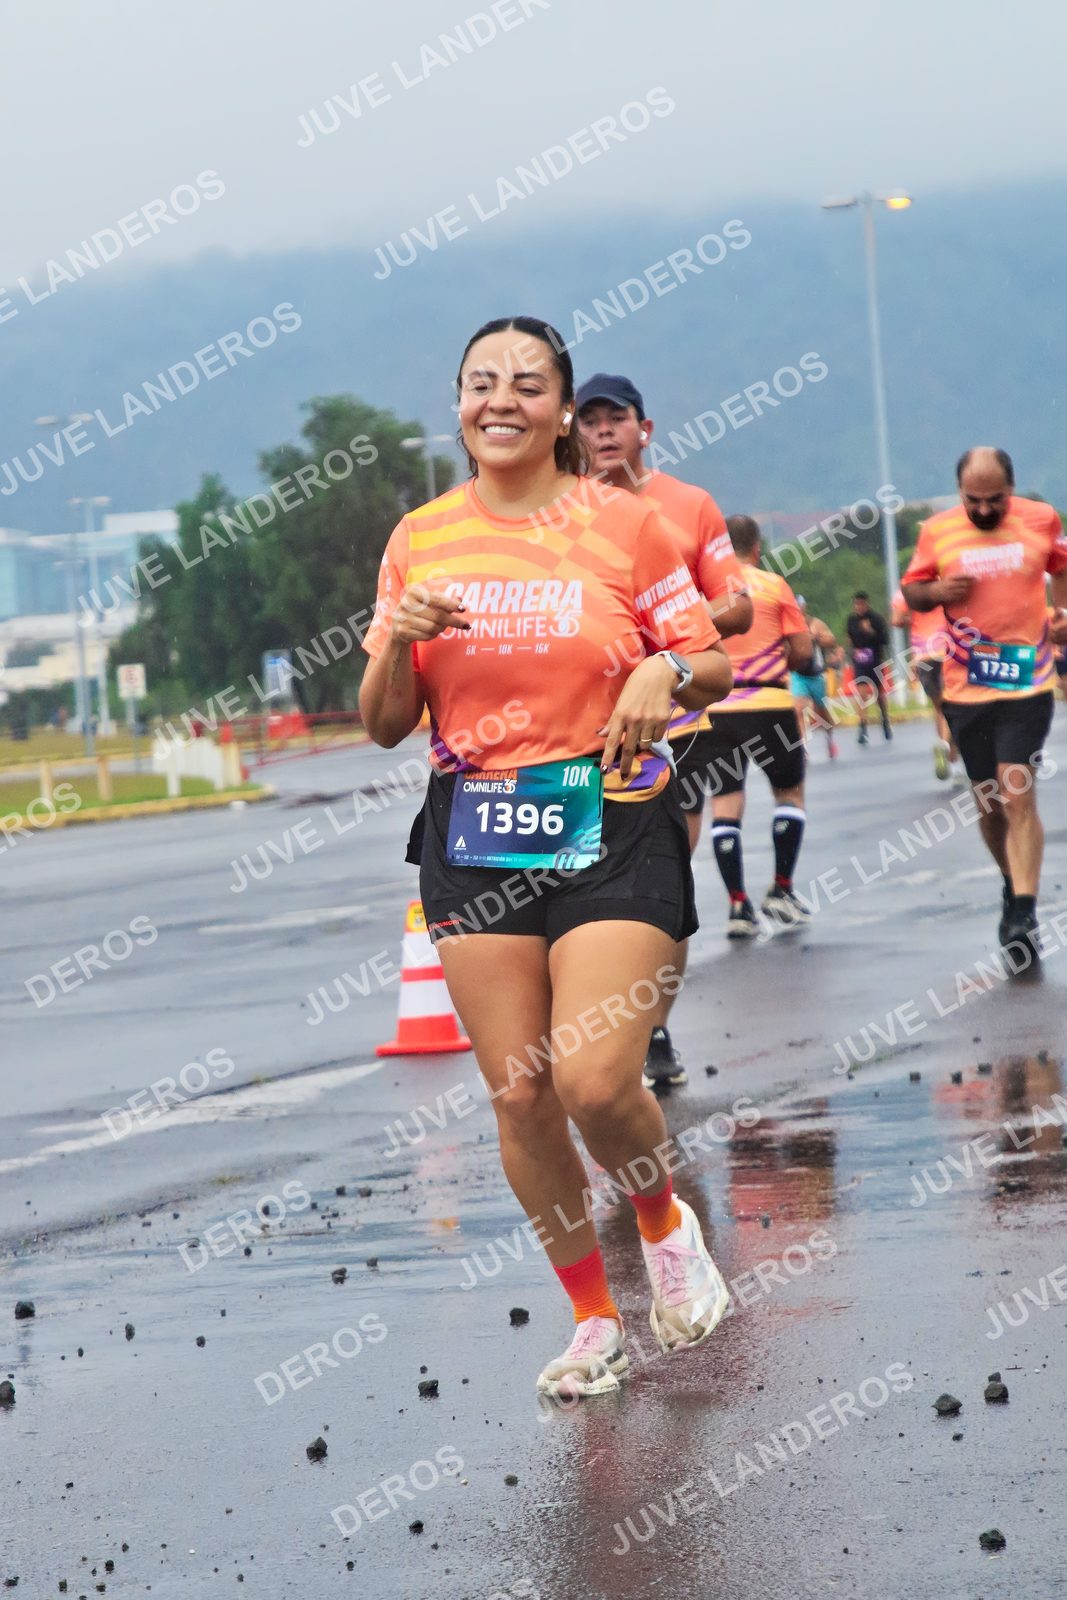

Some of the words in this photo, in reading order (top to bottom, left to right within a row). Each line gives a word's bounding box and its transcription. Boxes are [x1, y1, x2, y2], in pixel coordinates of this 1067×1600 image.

[444, 579, 583, 613] CARRERA
[980, 660, 1020, 680] 1723
[463, 781, 503, 793] OMNILIFE
[562, 765, 592, 787] 10K
[476, 801, 564, 835] 1396
